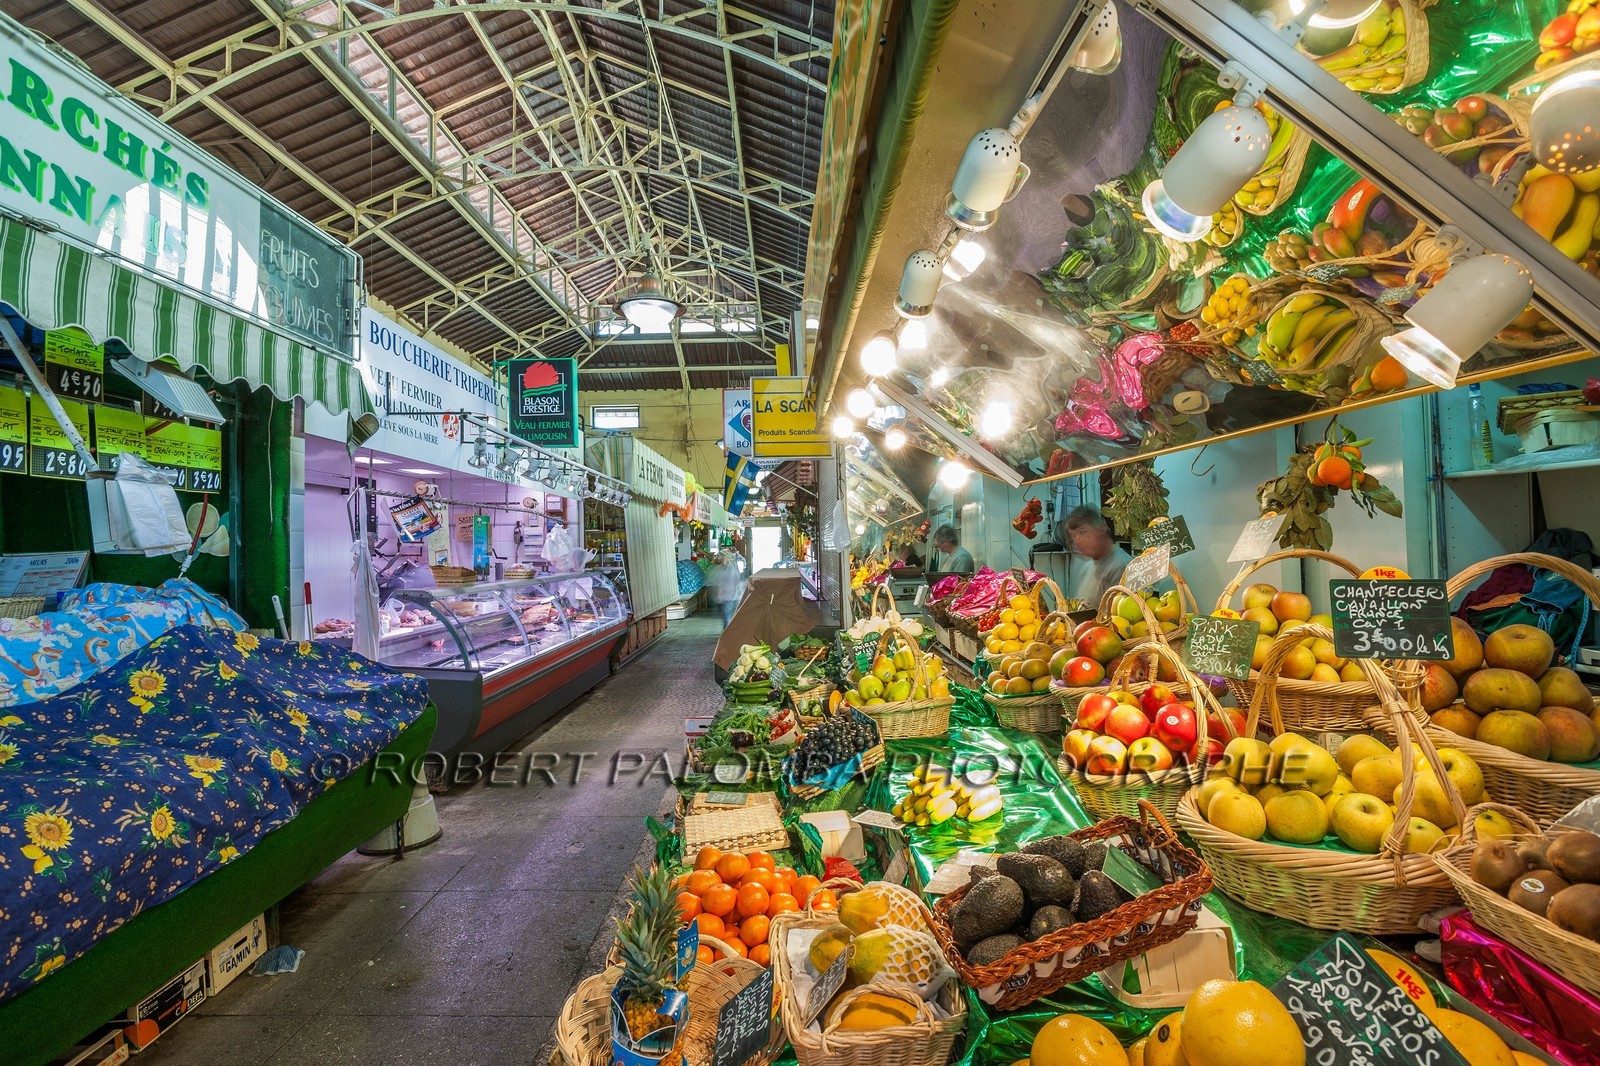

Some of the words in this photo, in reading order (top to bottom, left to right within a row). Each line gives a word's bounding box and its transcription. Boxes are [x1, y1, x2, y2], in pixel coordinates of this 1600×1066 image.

[0, 57, 209, 212] RCHÉS
[260, 229, 320, 289] FRUITS
[58, 344, 90, 357] TOMATE
[369, 319, 452, 383] BOUCHERIE
[453, 366, 499, 407] TRIPERIE
[401, 379, 442, 410] FERMIER
[524, 396, 560, 406] BLASON
[391, 399, 439, 429] LIMOUSIN
[523, 404, 560, 414] PRESTIGE
[755, 400, 774, 414] LA
[398, 422, 414, 438] SOUS
[414, 430, 423, 439] LA
[513, 419, 536, 430] VEAU
[538, 420, 571, 430] FERMIER
[758, 429, 787, 437] Produits
[527, 432, 567, 441] LIMOUSIN
[64, 556, 80, 565] 2006
[1373, 568, 1396, 579] 1kg
[1333, 580, 1445, 600] CHANTECLER
[225, 943, 251, 974] GAMIN
[1395, 967, 1427, 1001] 1kg
[756, 971, 773, 1032] ANANAS
[1386, 985, 1444, 1044] ROSE
